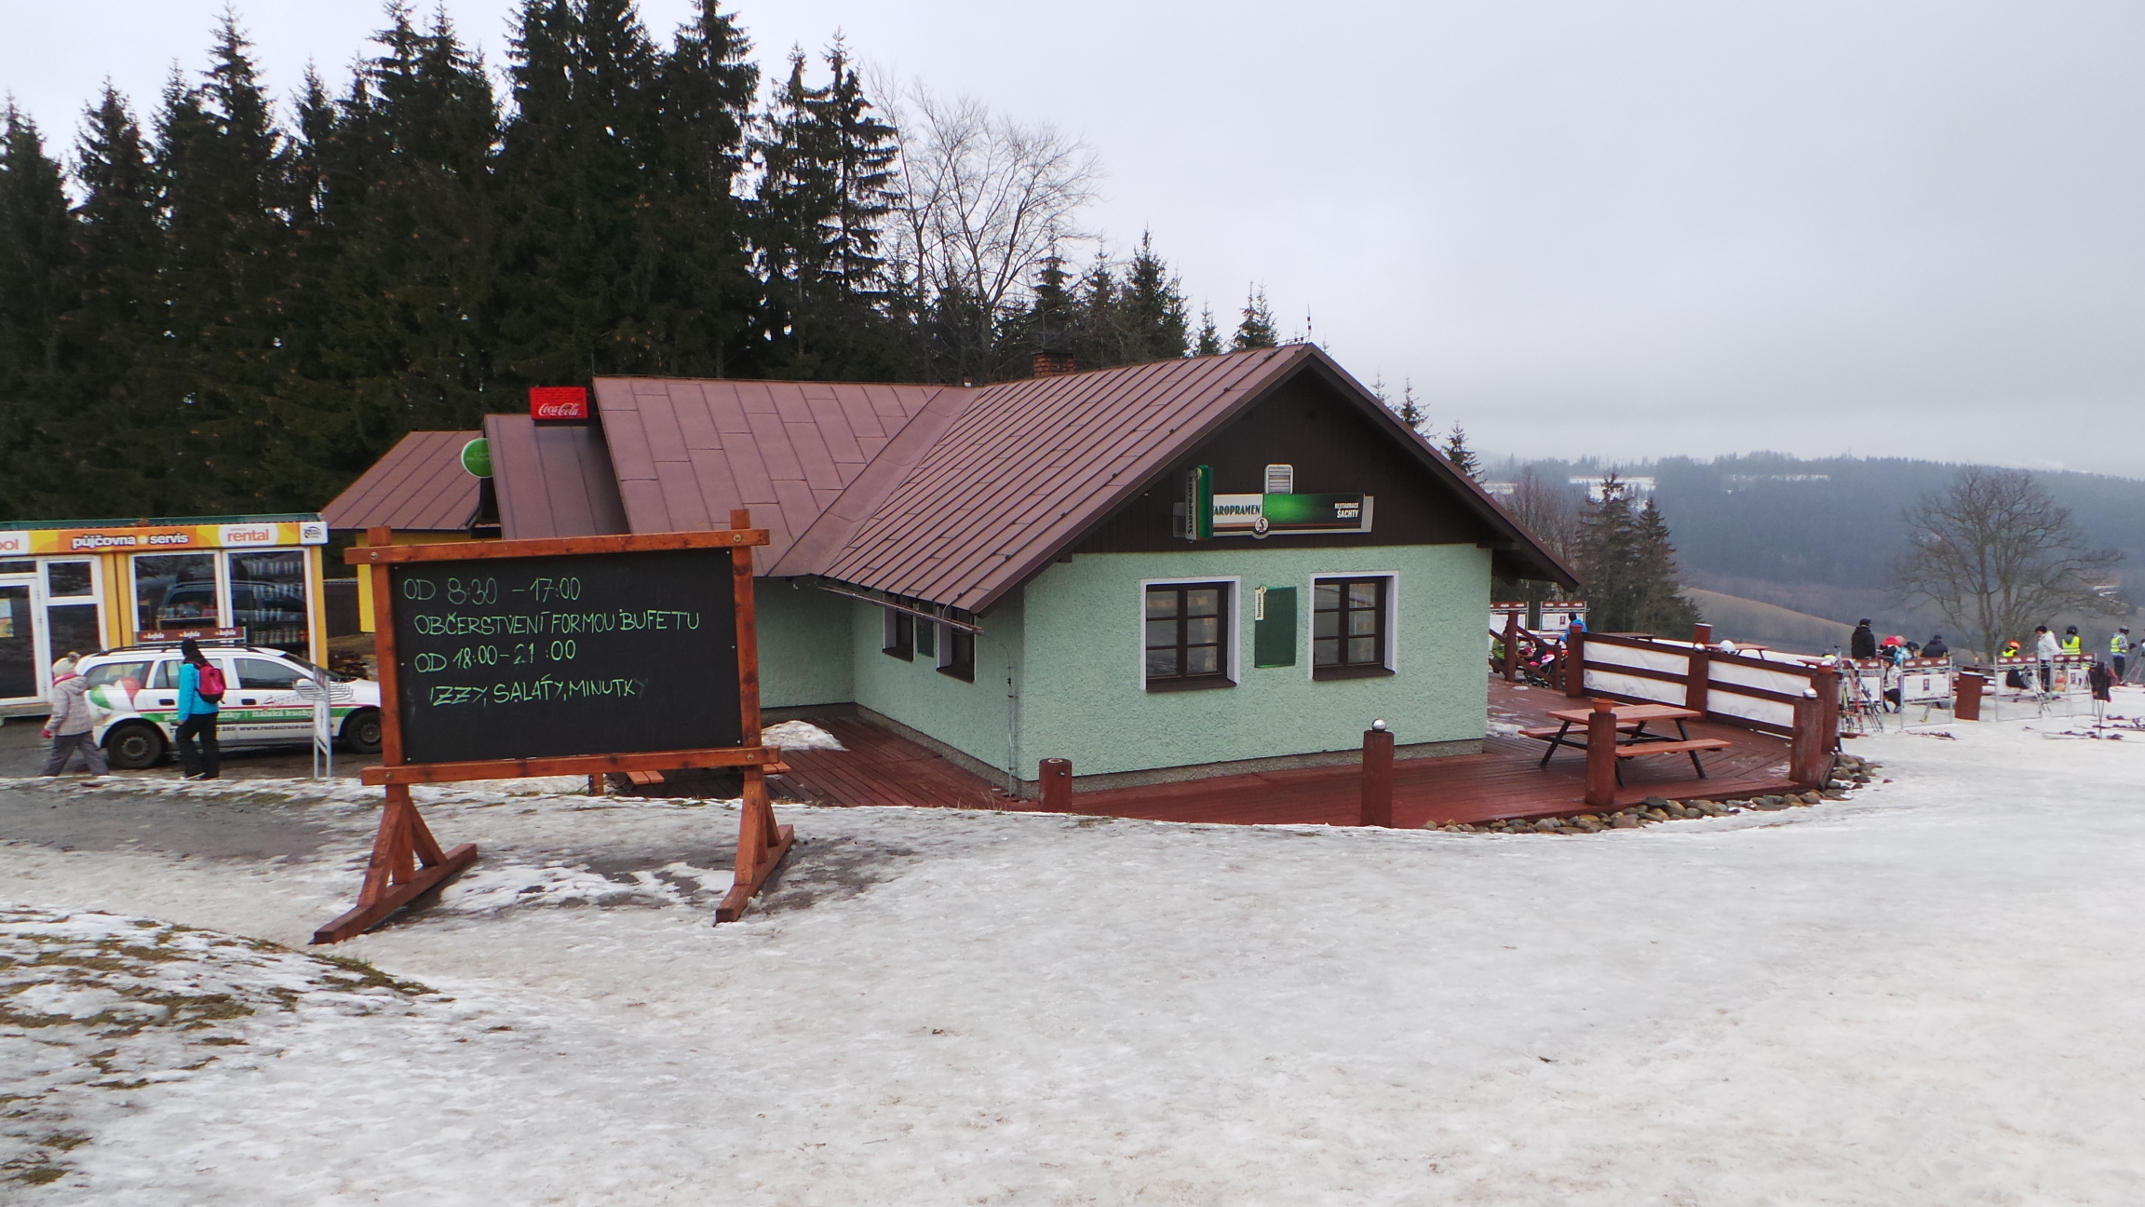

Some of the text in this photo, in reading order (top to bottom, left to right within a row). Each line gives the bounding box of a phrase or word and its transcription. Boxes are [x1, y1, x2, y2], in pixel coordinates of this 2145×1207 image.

[538, 402, 581, 417] Coca-Cola
[1213, 505, 1261, 516] AROPRAMEN
[150, 533, 189, 545] servis
[227, 529, 270, 542] rental
[0, 538, 19, 551] ol
[404, 578, 436, 600] OD
[448, 577, 498, 605] 8:30
[551, 612, 616, 634] FORMOU
[619, 609, 699, 631] BUFETU
[415, 653, 447, 673] OD
[430, 685, 488, 707] IZZY,
[285, 709, 314, 718] kuchy
